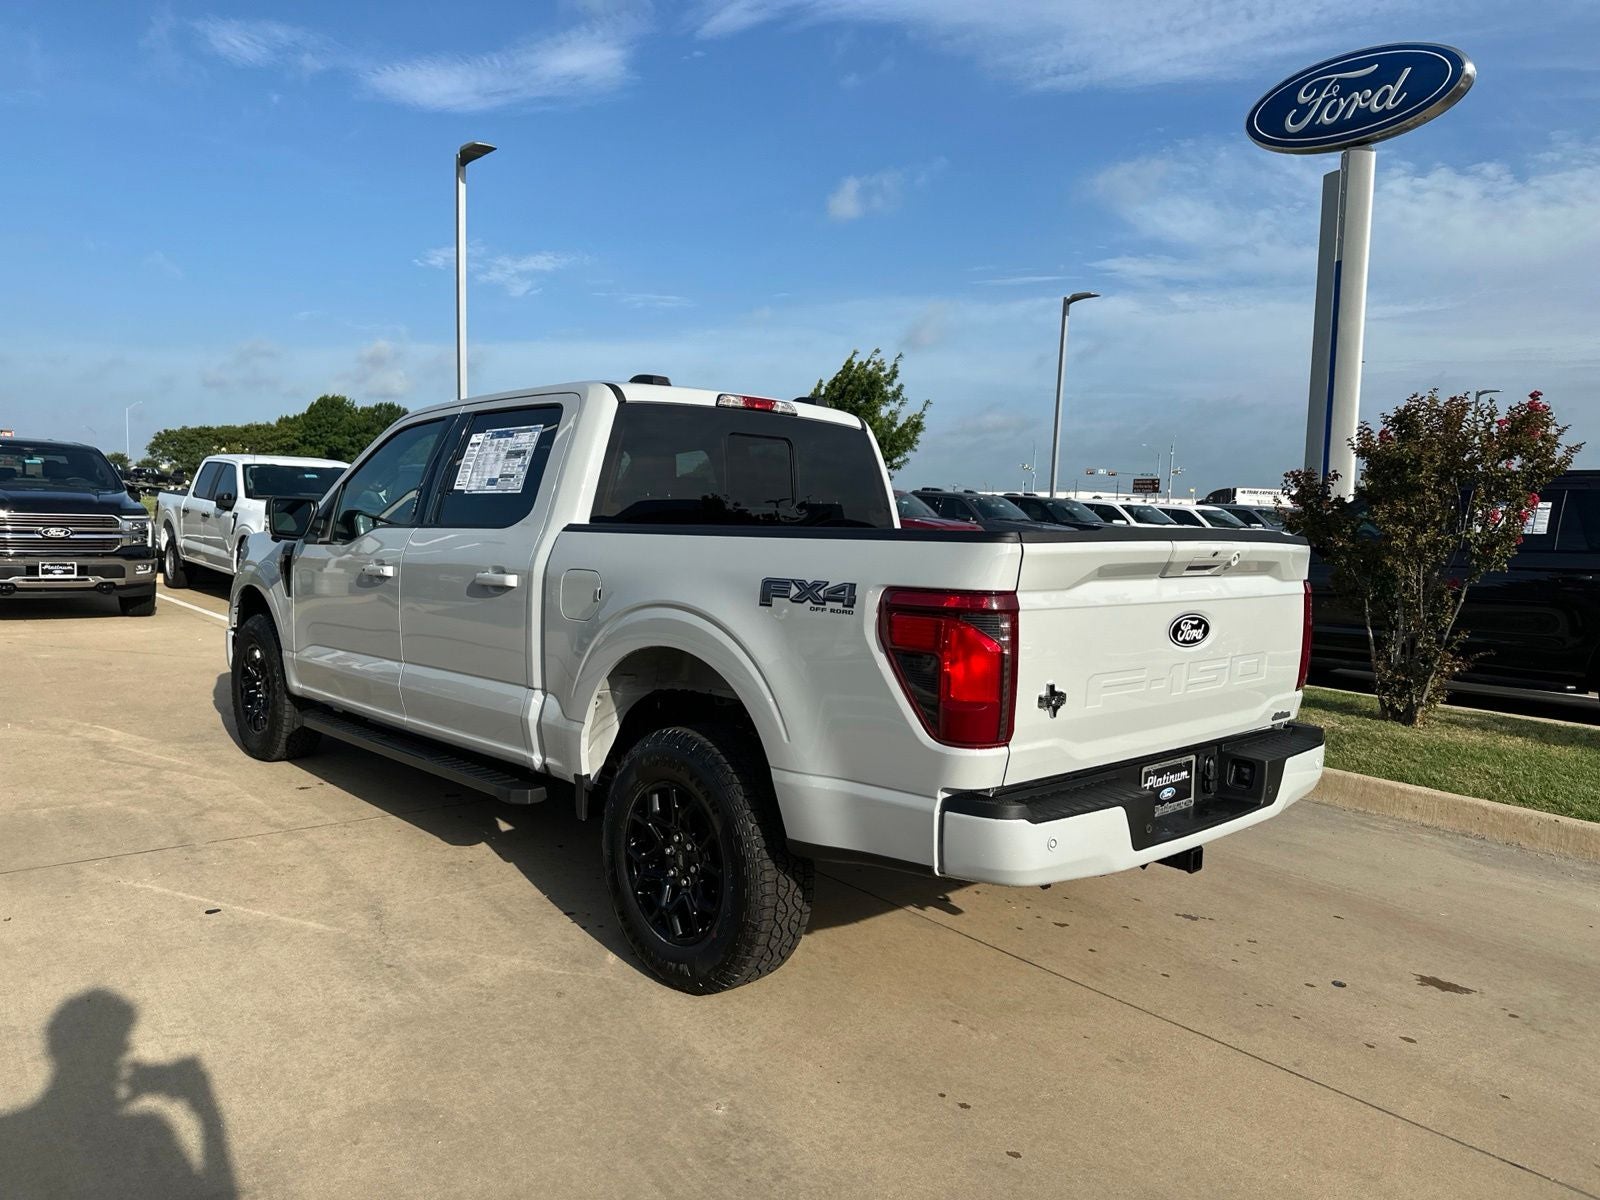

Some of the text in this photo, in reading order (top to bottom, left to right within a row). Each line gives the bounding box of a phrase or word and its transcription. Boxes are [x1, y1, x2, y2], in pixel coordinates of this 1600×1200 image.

[1285, 63, 1412, 133] Ford
[759, 577, 857, 608] FX4
[829, 607, 854, 616] ROAD
[1177, 619, 1204, 641] Ford
[1085, 651, 1267, 708] F-150
[1144, 770, 1190, 790] Platinum
